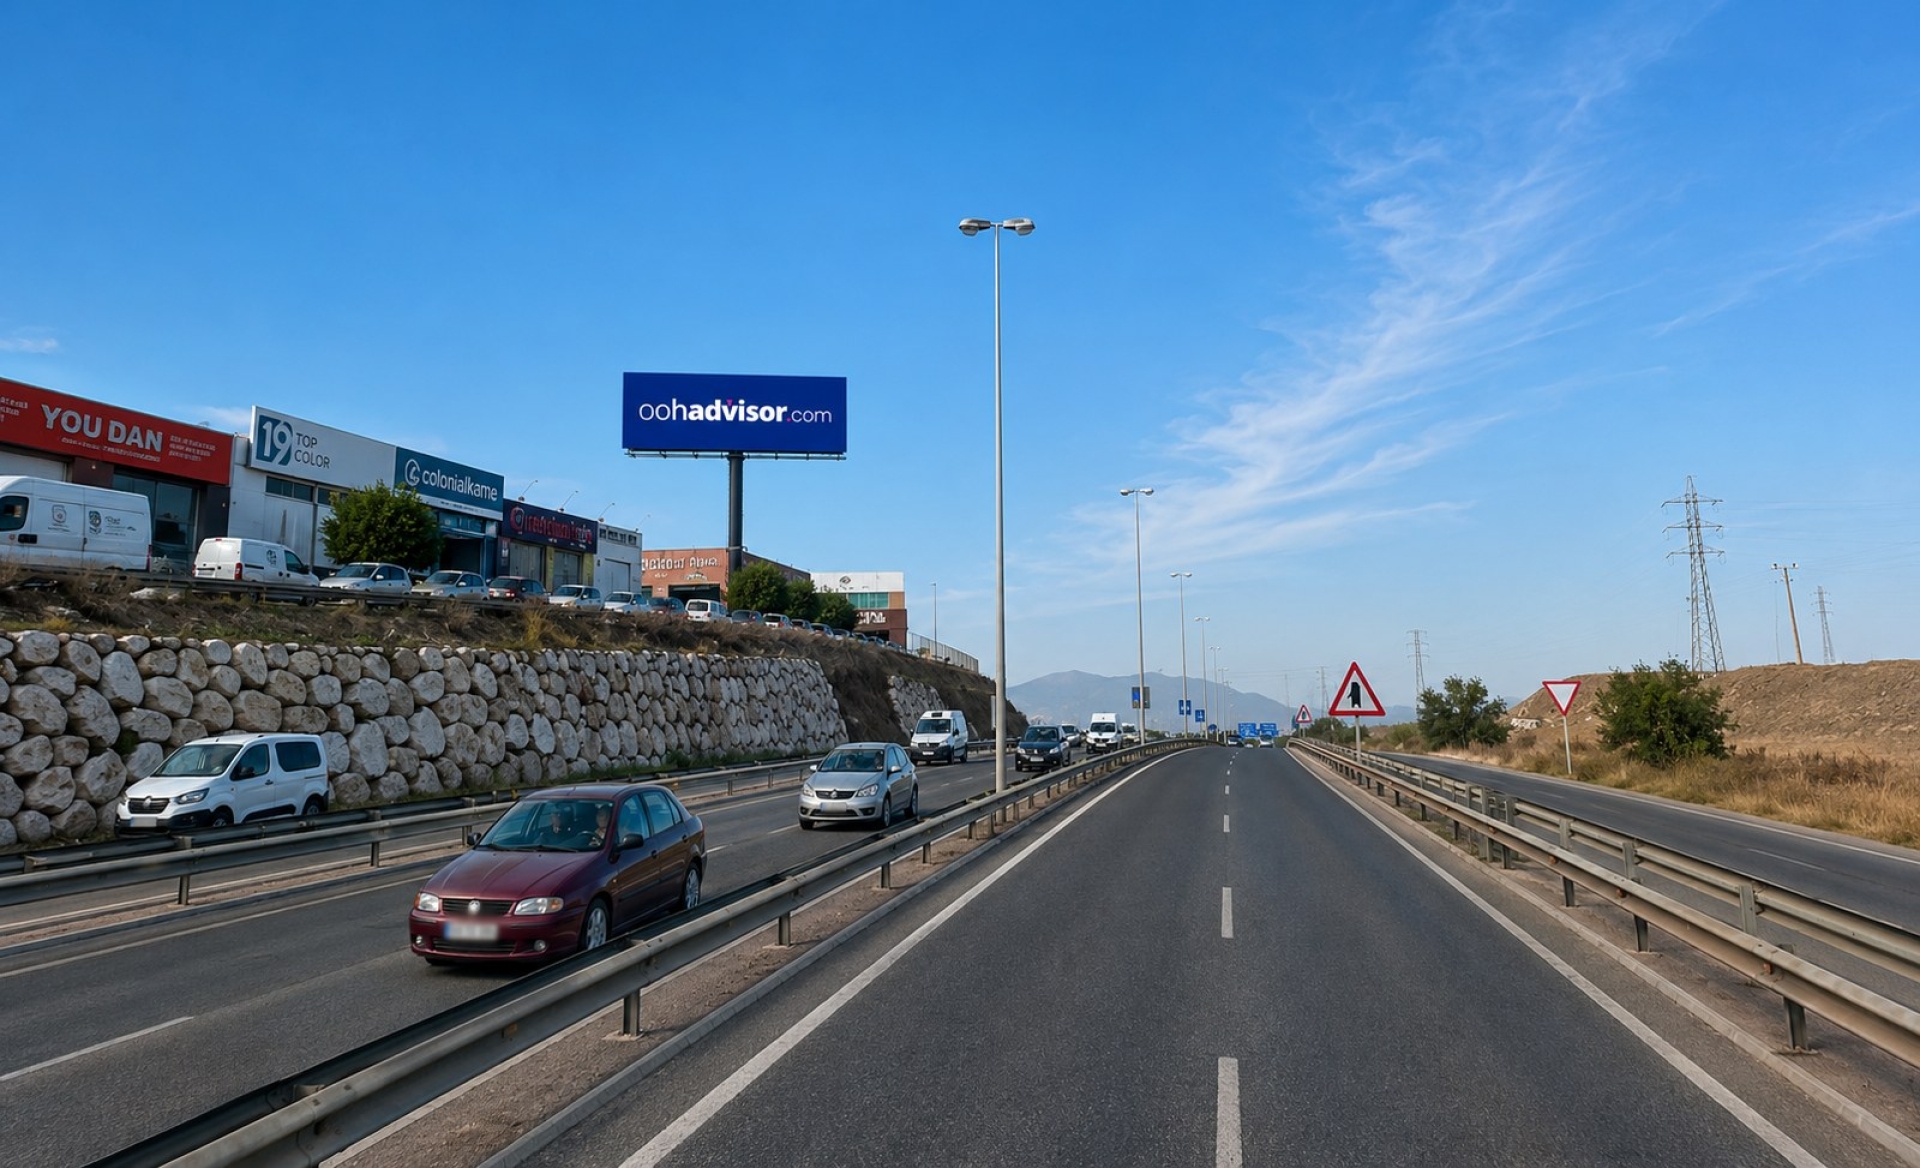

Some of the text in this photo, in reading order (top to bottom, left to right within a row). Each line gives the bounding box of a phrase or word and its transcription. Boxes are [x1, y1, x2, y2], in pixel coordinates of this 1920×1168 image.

[639, 398, 832, 423] oohadvisor.com
[41, 404, 103, 438] YOU
[107, 420, 163, 452] DAN
[295, 432, 318, 449] TOP
[294, 450, 331, 469] COLOR
[421, 468, 498, 502] colonialkame
